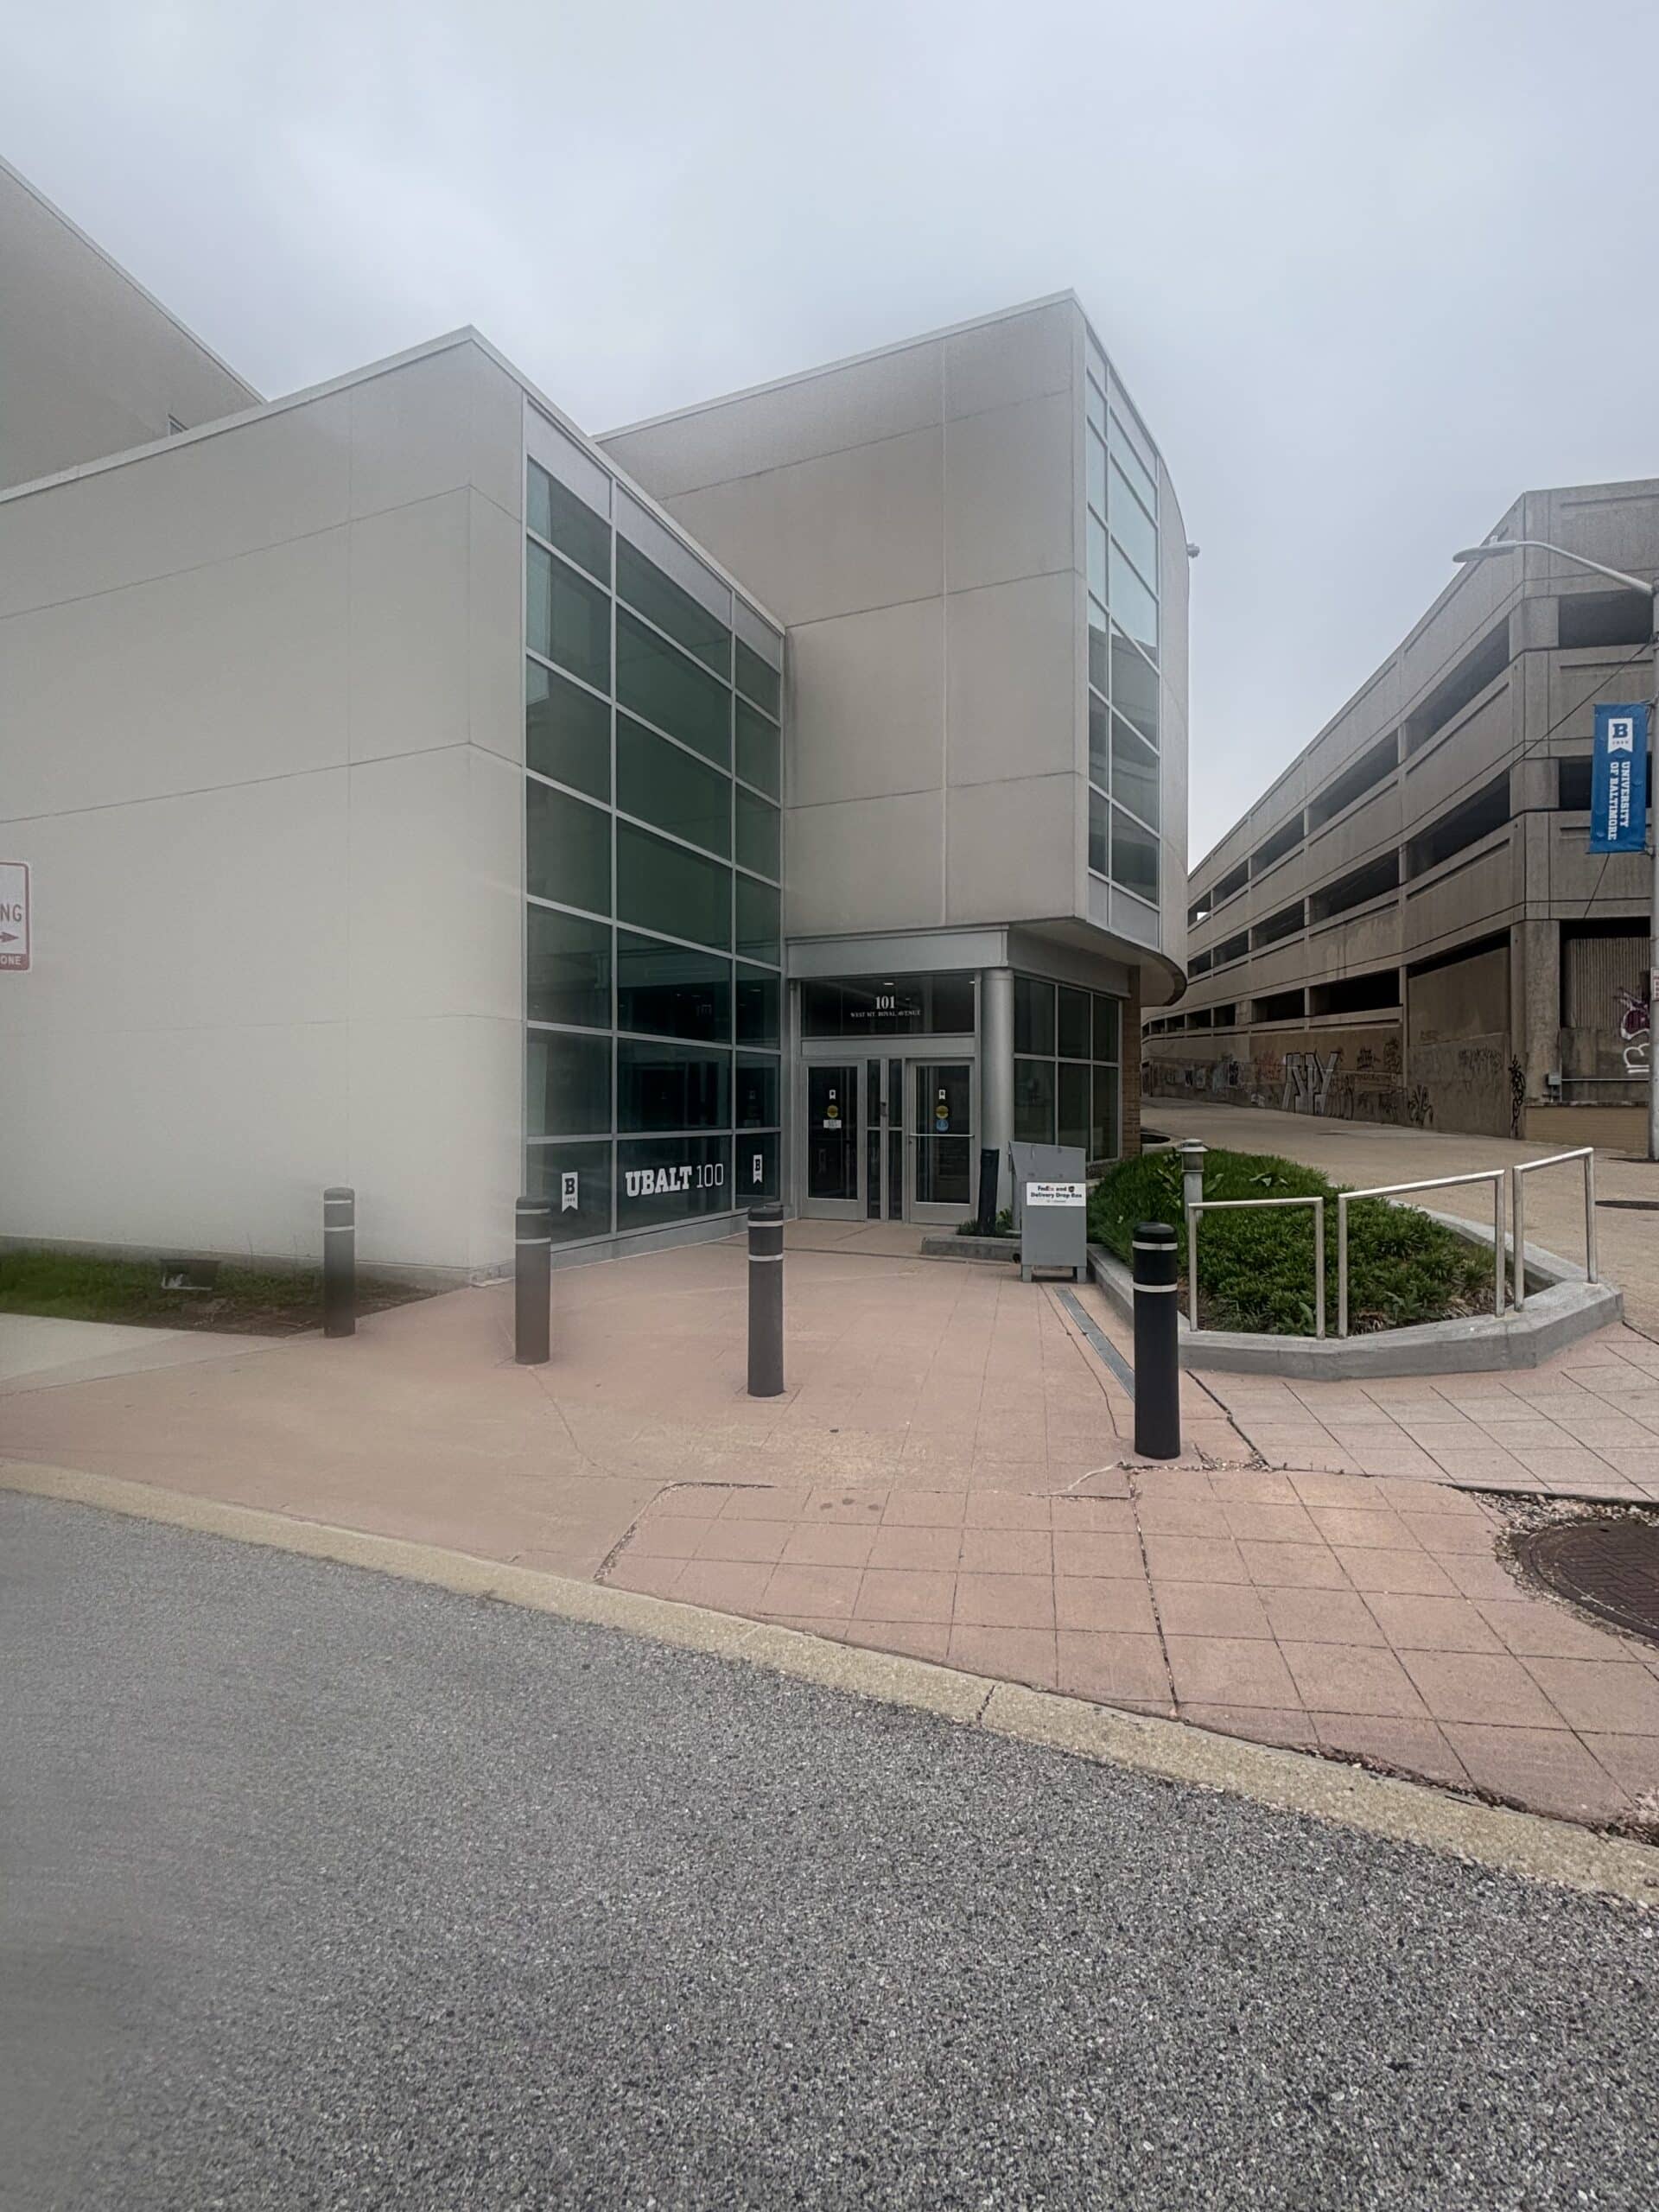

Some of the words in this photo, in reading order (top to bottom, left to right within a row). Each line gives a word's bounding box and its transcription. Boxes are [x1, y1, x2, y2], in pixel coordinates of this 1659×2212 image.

[1612, 723, 1628, 738] B
[1610, 762, 1618, 775] OF
[1620, 761, 1630, 827] UNIVERSITY
[1608, 779, 1618, 841] BALTIMORE
[875, 995, 895, 1009] 101
[564, 1178, 575, 1194] B
[625, 1166, 692, 1198] UBALT
[696, 1163, 724, 1188] 100
